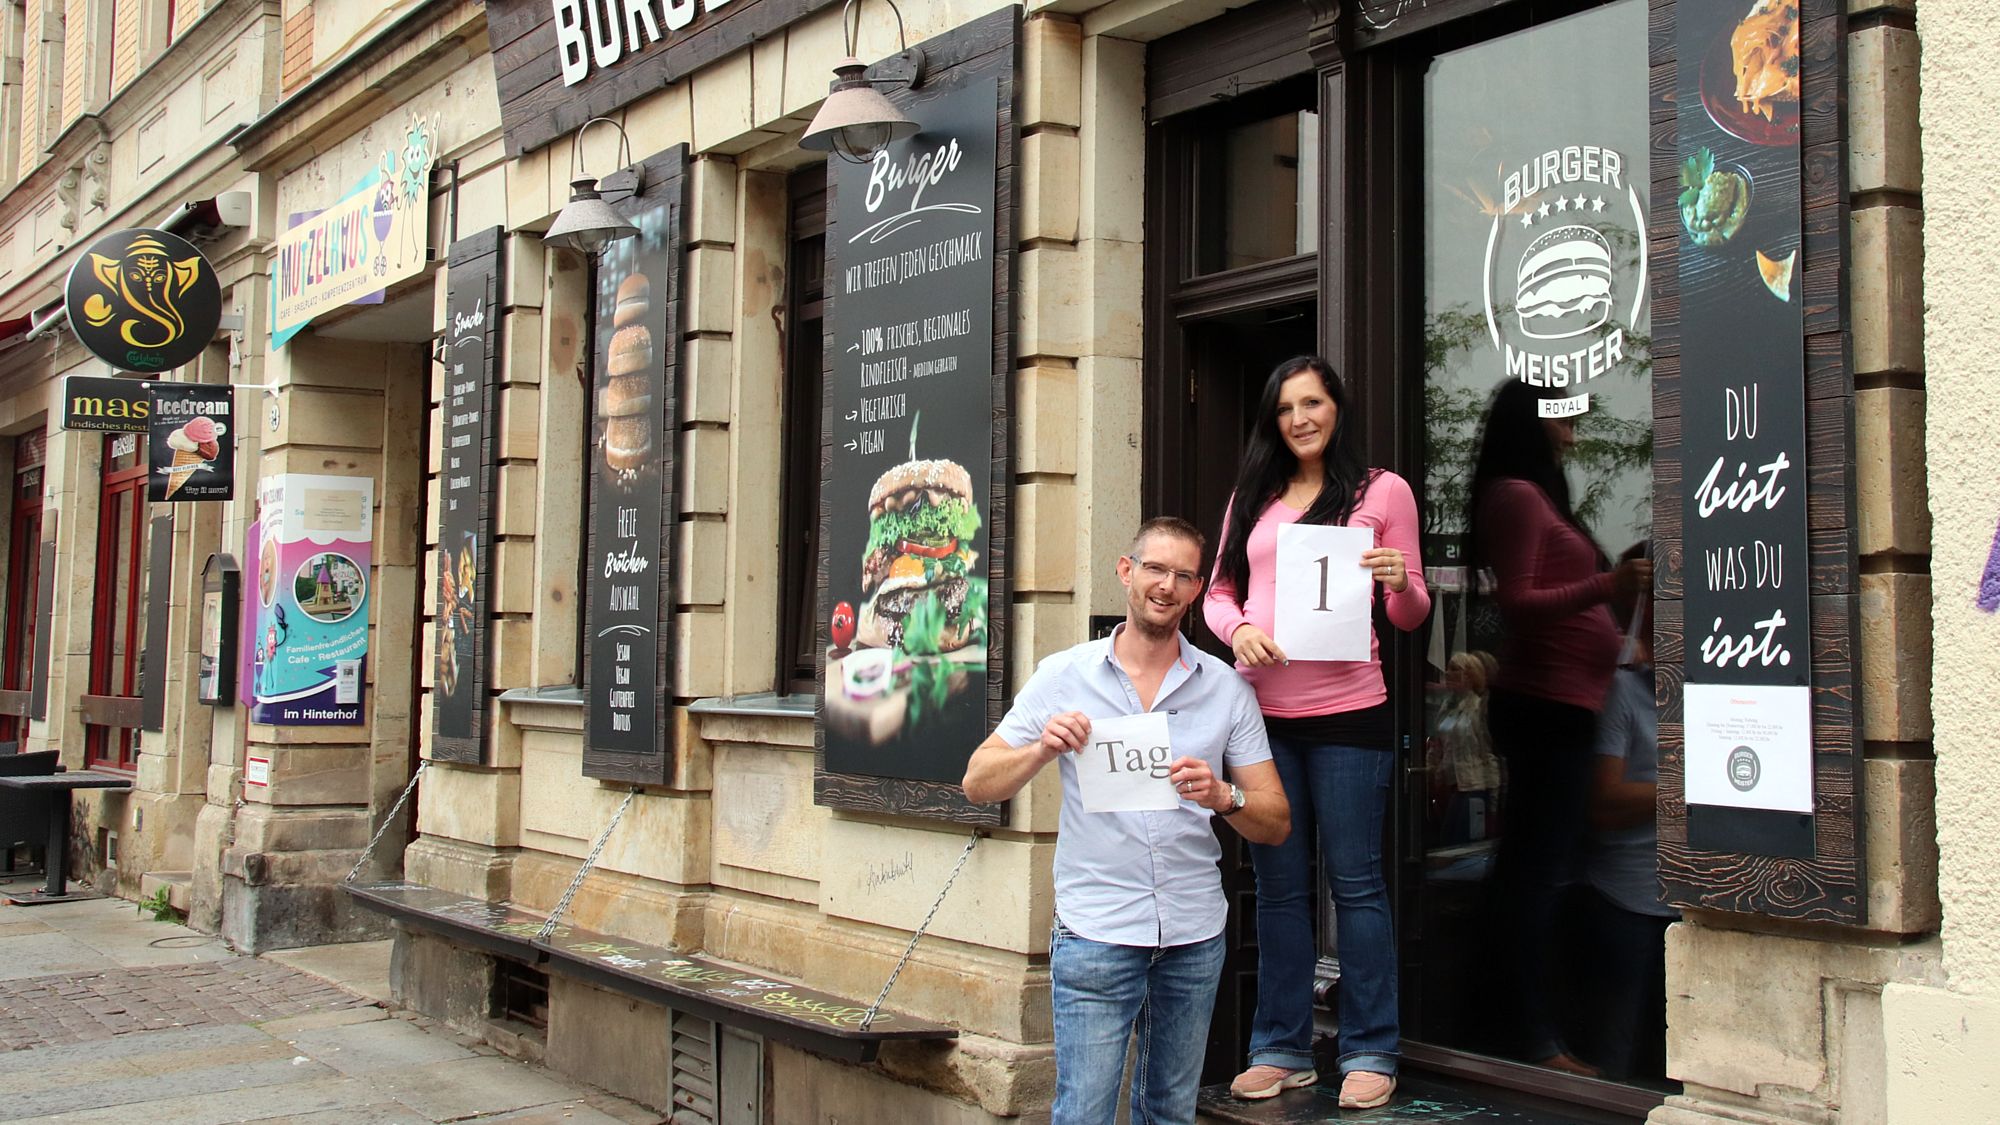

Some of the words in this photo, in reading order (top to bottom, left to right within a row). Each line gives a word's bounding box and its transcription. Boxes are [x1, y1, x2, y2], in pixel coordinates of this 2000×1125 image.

[554, 0, 730, 87] BUR
[865, 137, 962, 213] Burger
[1504, 145, 1621, 215] BURGER
[845, 264, 862, 294] WIR
[864, 255, 898, 288] TREFFEN
[899, 246, 927, 284] JEDEN
[928, 231, 982, 272] GESCHMACK
[454, 298, 485, 338] Snacks
[861, 326, 884, 356] 100%
[886, 320, 922, 351] FRISCHES,
[923, 309, 971, 343] REGIONALES
[126, 351, 164, 367] Carlsberg
[860, 356, 907, 388] RINDFLEISCH
[913, 361, 934, 379] MEDIUM
[1505, 328, 1623, 388] MEISTER
[71, 420, 120, 430] Indisches
[123, 423, 148, 431] Rest
[72, 396, 149, 419] mas
[156, 398, 229, 415] IceCream
[860, 393, 906, 424] VEGETARISCH
[1545, 399, 1582, 415] ROYAL
[1725, 382, 1758, 441] DU
[859, 429, 885, 455] VEGAN
[1694, 452, 1790, 518] bist
[618, 505, 638, 539] FREIE
[604, 540, 649, 579] Brötchen
[1705, 546, 1747, 592] WAS
[1754, 540, 1782, 589] DU
[609, 584, 640, 612] AUSWAHL
[1312, 555, 1334, 612] 1
[286, 626, 365, 653] Familienfreundliches
[288, 655, 310, 664] Cafe
[318, 637, 366, 661] Restaurant
[1700, 608, 1791, 668] isst.
[284, 708, 299, 719] im
[303, 708, 358, 719] Hinterhof
[1095, 739, 1170, 780] Tag
